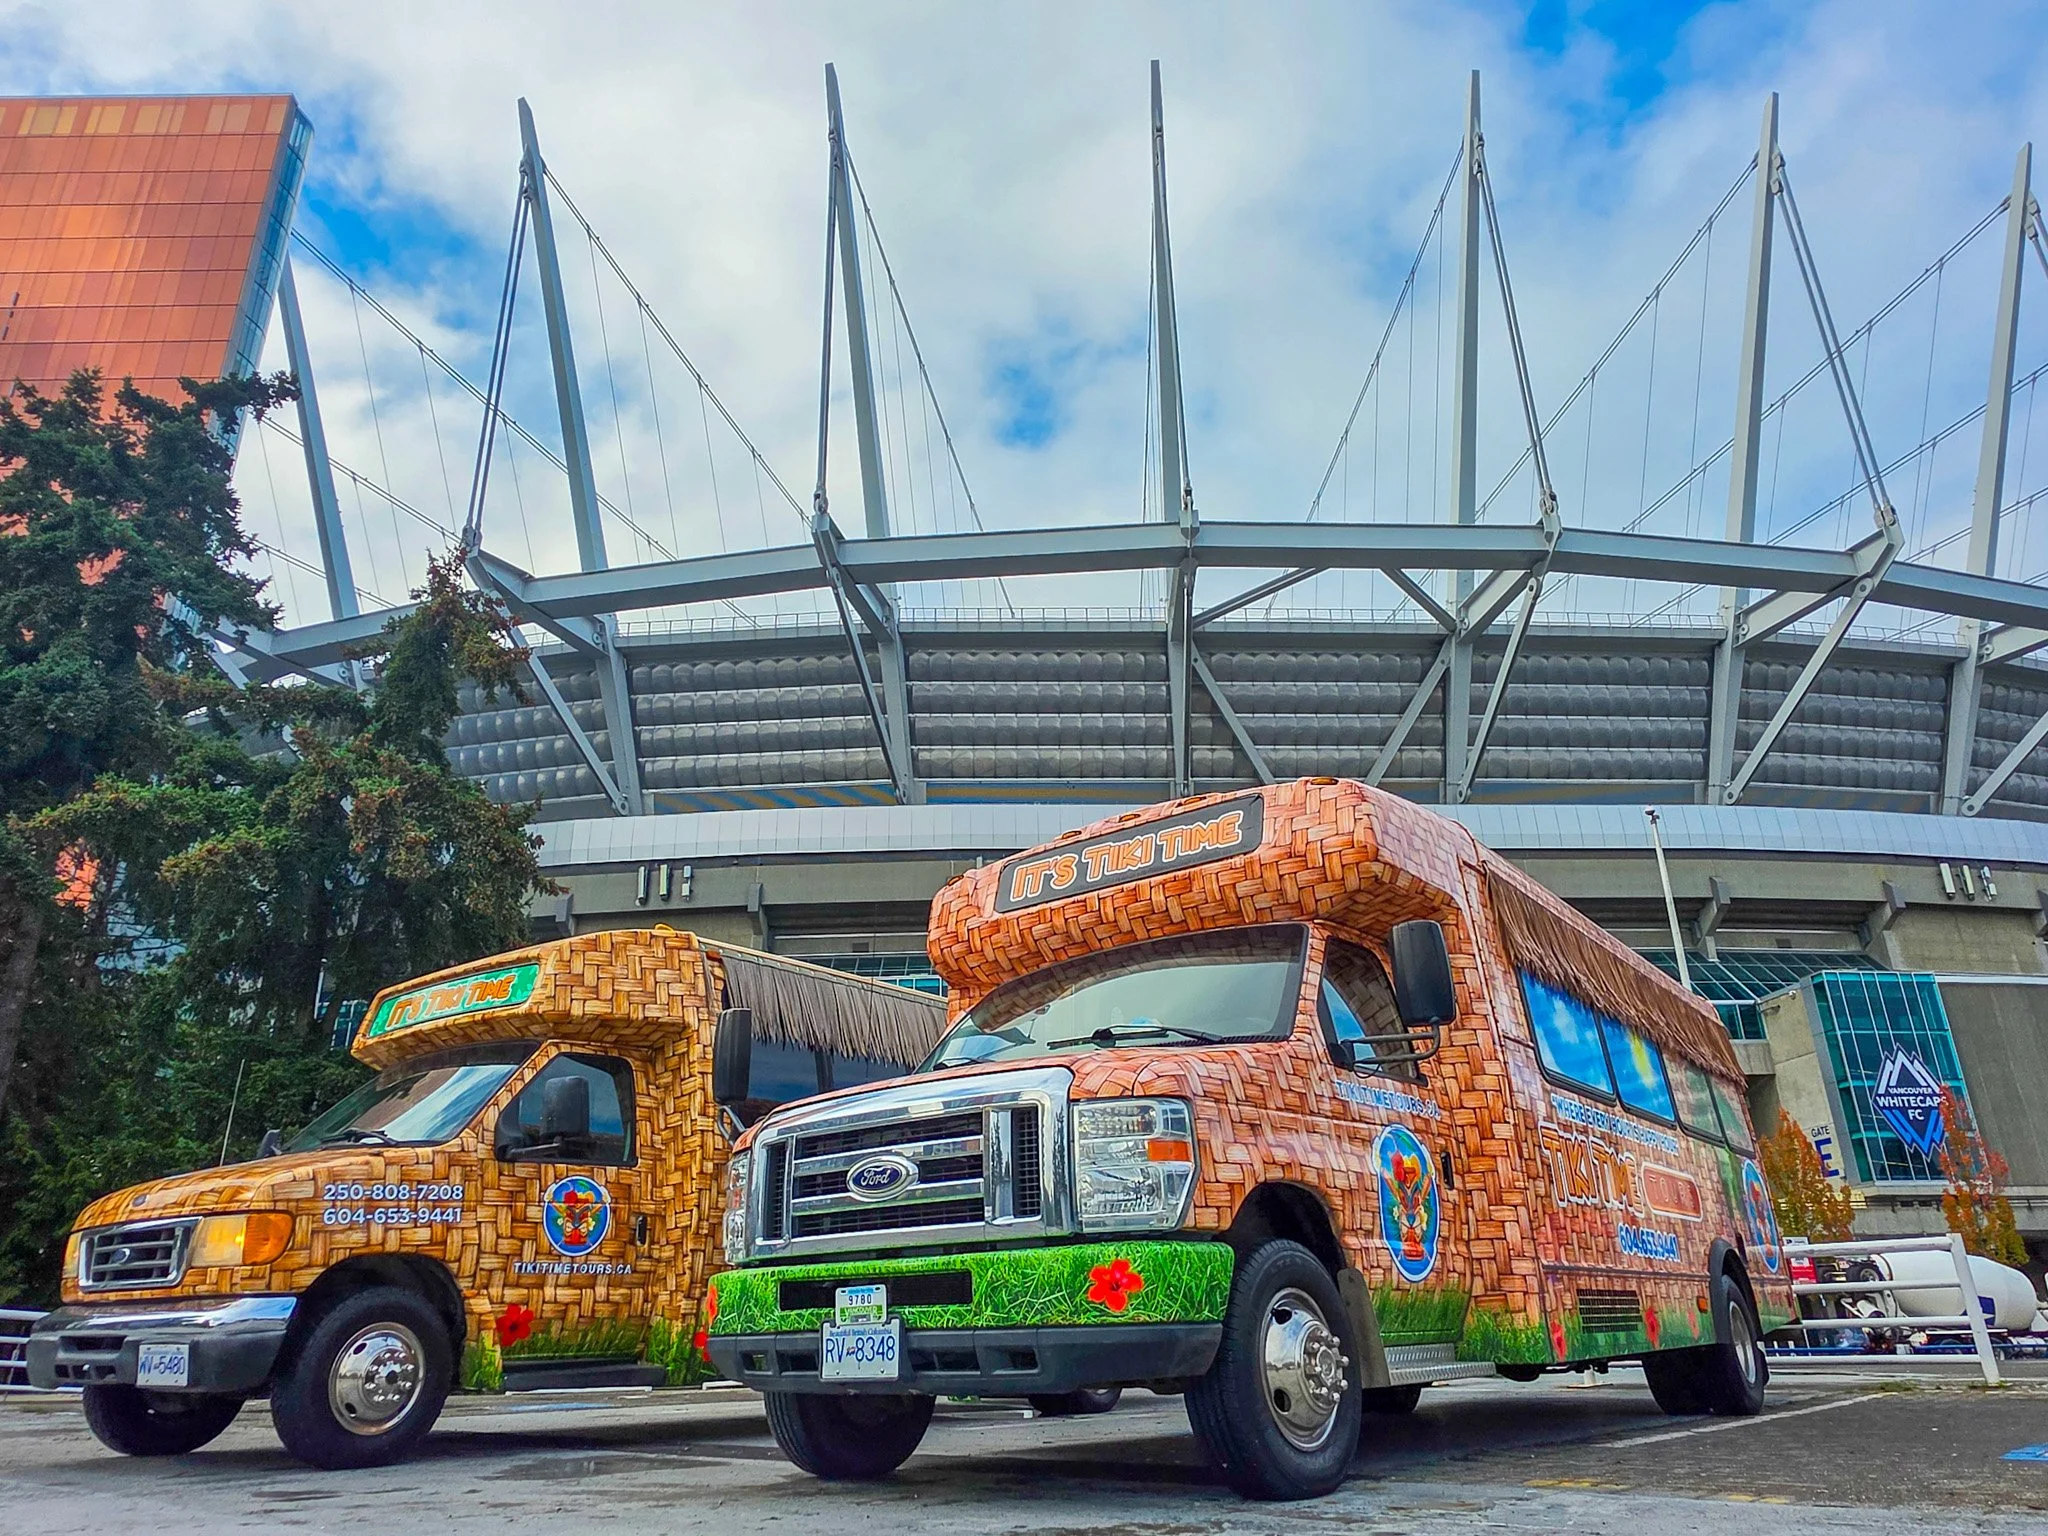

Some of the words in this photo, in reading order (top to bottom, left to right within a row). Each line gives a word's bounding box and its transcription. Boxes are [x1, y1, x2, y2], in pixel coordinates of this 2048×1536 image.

[1010, 852, 1079, 902] IT'S
[1082, 831, 1156, 882] TIKI
[1157, 809, 1245, 862] TIME
[385, 994, 426, 1030] IT'S
[463, 972, 518, 1008] TIME
[1887, 1086, 1934, 1096] VANCOUVER
[1907, 1109, 1925, 1121] FC
[1811, 1126, 1830, 1138] GATE
[1538, 1120, 1600, 1207] TIKI
[1814, 1137, 1840, 1178] E
[860, 1166, 892, 1186] Ford
[323, 1184, 463, 1200] 250-808-7208
[323, 1207, 462, 1224] 604-653-9441
[513, 1262, 632, 1275] TIKITIMETOURS.CA
[848, 1293, 872, 1306] 9780
